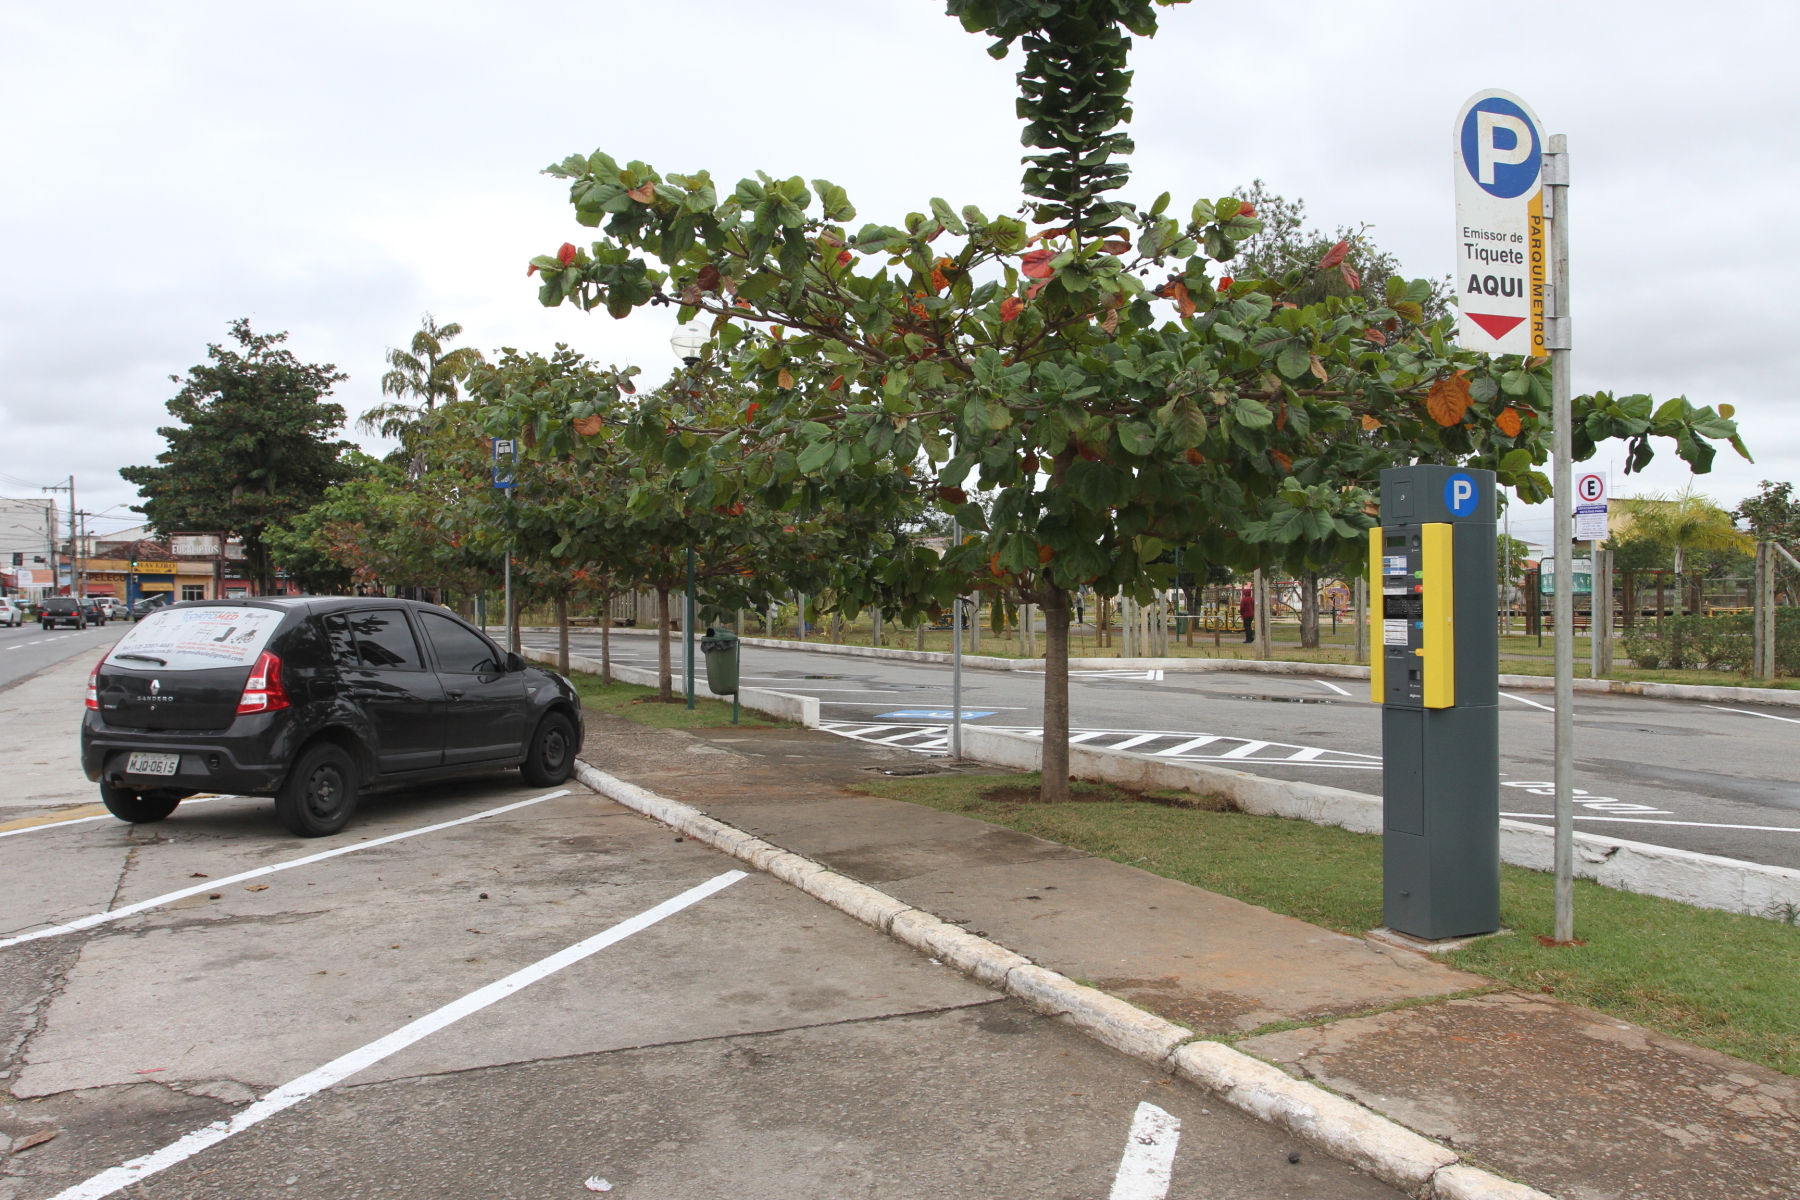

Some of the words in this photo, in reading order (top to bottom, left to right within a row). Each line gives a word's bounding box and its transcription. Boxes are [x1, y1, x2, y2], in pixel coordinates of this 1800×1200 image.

[1476, 110, 1533, 185] P
[1463, 226, 1507, 242] Emissor
[1510, 232, 1524, 243] de
[1464, 243, 1524, 265] Tíquete
[1467, 273, 1524, 298] AQUI
[1453, 480, 1472, 510] P
[1587, 480, 1596, 496] E
[171, 544, 219, 555] EUCALIPTOS
